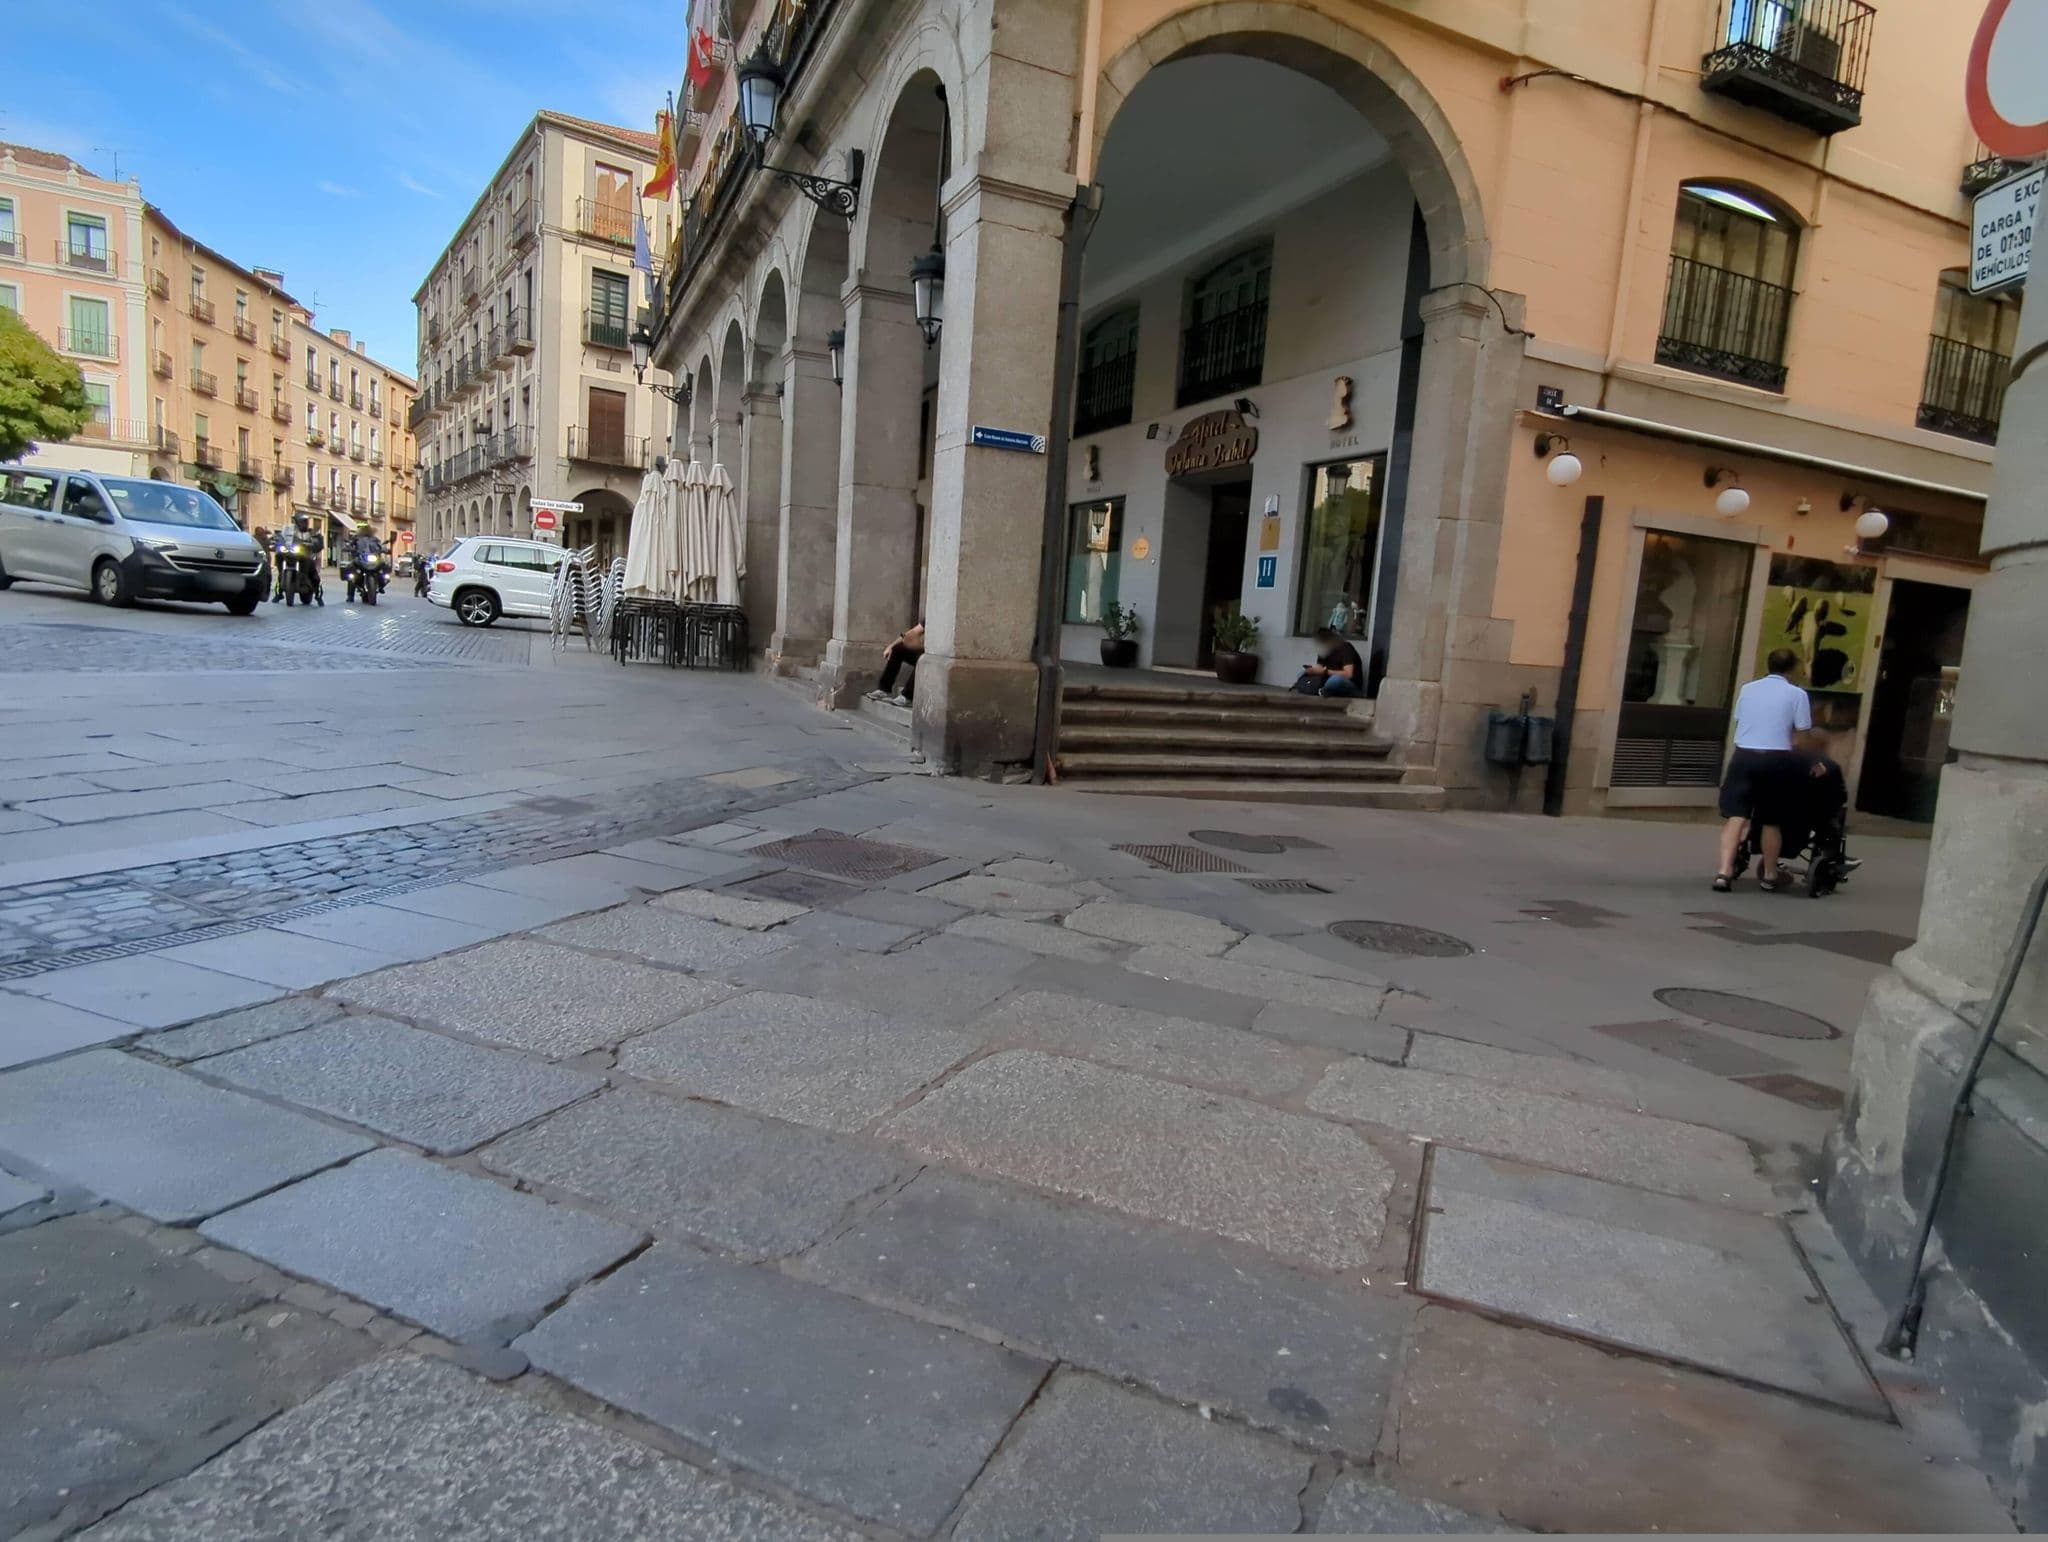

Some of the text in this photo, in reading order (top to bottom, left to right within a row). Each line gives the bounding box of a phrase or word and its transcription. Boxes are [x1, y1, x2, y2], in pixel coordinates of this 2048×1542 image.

[2014, 176, 2046, 203] EXC
[1981, 203, 2036, 239] CARGA Y
[1977, 226, 2031, 261] DE 07:30
[1975, 250, 2031, 281] VEHÍCULOS
